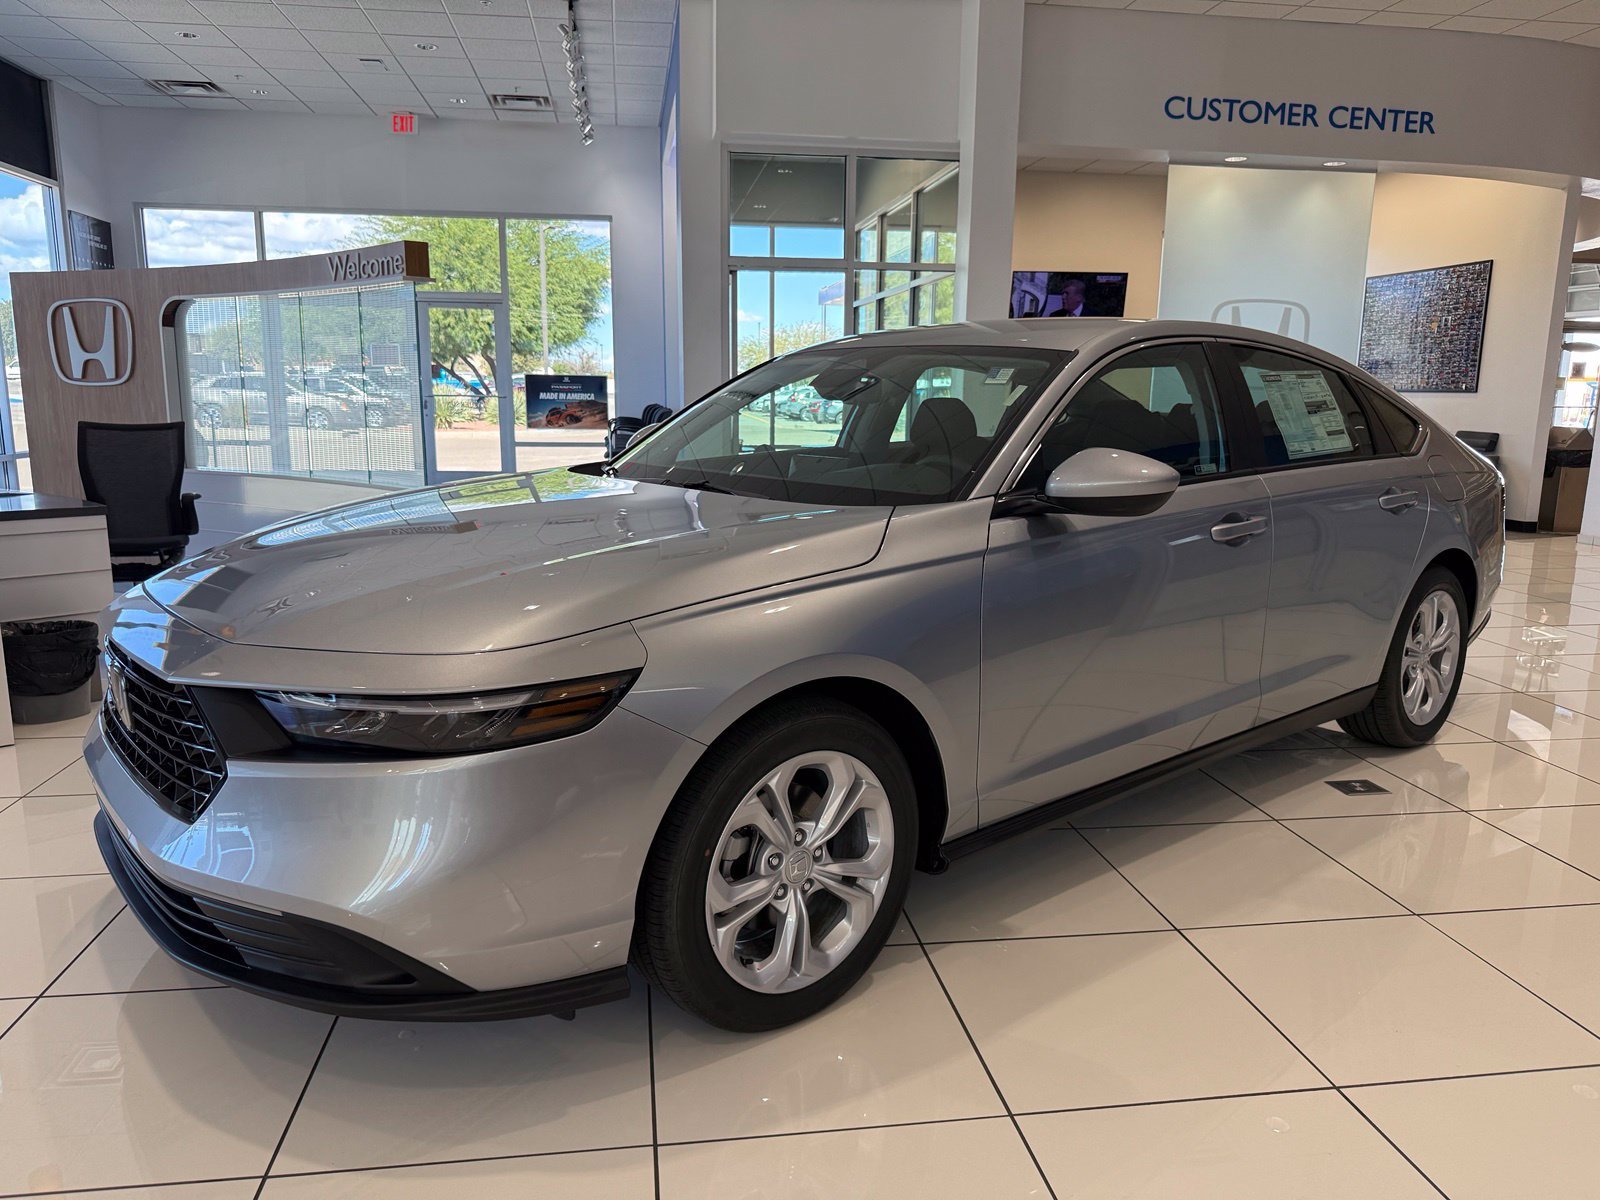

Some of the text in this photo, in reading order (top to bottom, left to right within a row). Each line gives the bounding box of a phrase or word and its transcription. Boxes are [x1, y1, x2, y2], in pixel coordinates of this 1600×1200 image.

[393, 115, 414, 133] EXIT
[1164, 95, 1436, 135] CUSTOMER CENTER
[327, 253, 405, 281] Welcome
[539, 392, 558, 400] MADE
[559, 392, 566, 400] IN
